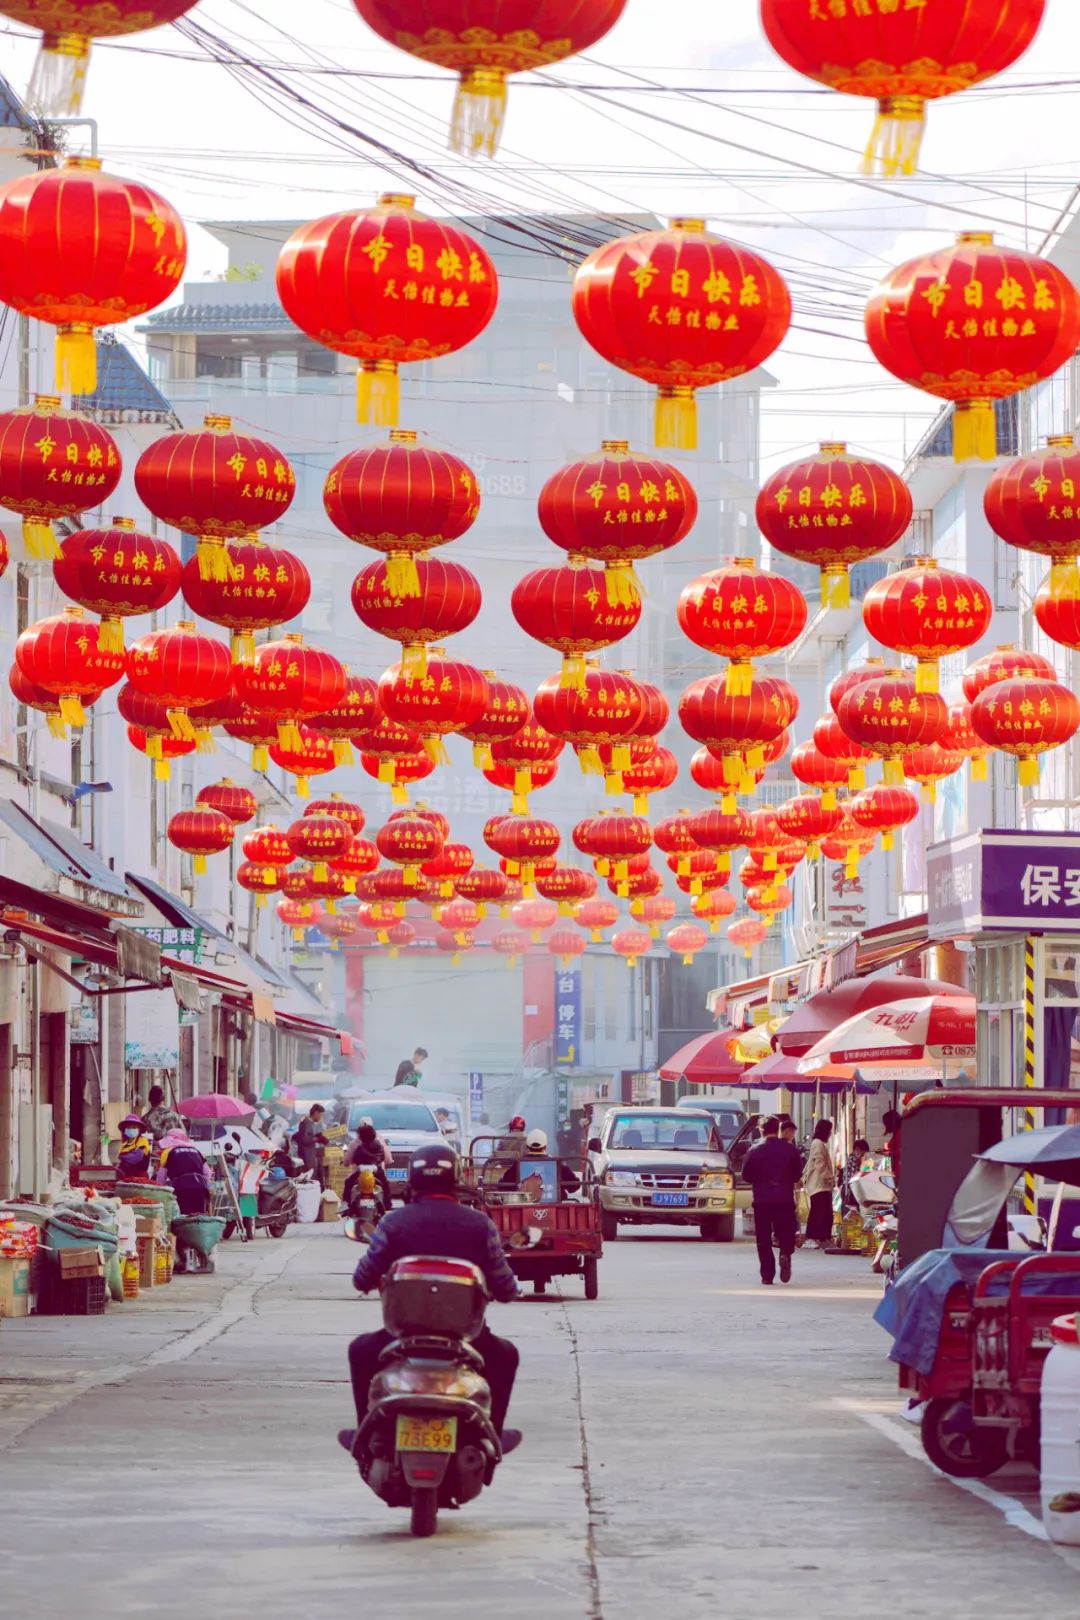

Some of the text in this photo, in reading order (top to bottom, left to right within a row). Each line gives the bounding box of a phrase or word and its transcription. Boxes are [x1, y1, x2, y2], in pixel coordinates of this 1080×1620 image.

[362, 236, 487, 284] 节日快乐
[383, 281, 470, 308] 天怡佳物业
[628, 261, 762, 307] 节日快乐
[922, 275, 1056, 319] 节日快乐
[647, 306, 740, 331] 天怡佳物业
[944, 319, 1037, 339] 天怡佳物业
[34, 436, 118, 467] 节日快乐
[47, 468, 106, 486] 天怡佳物业
[585, 480, 680, 509] 节日快乐
[774, 483, 867, 513] 节日快乐
[603, 510, 668, 524] 天怡佳物业
[788, 514, 853, 529] 天怡佳物业
[90, 545, 166, 572] 节日快乐
[97, 571, 153, 586] 天怡佳物业
[228, 563, 289, 583] 日快乐
[222, 585, 277, 598] 天怡佳物业
[911, 592, 984, 614] 节日快乐
[576, 687, 639, 705] 节日快乐
[856, 695, 921, 713] 节日快乐
[986, 698, 1052, 718] 节日快乐
